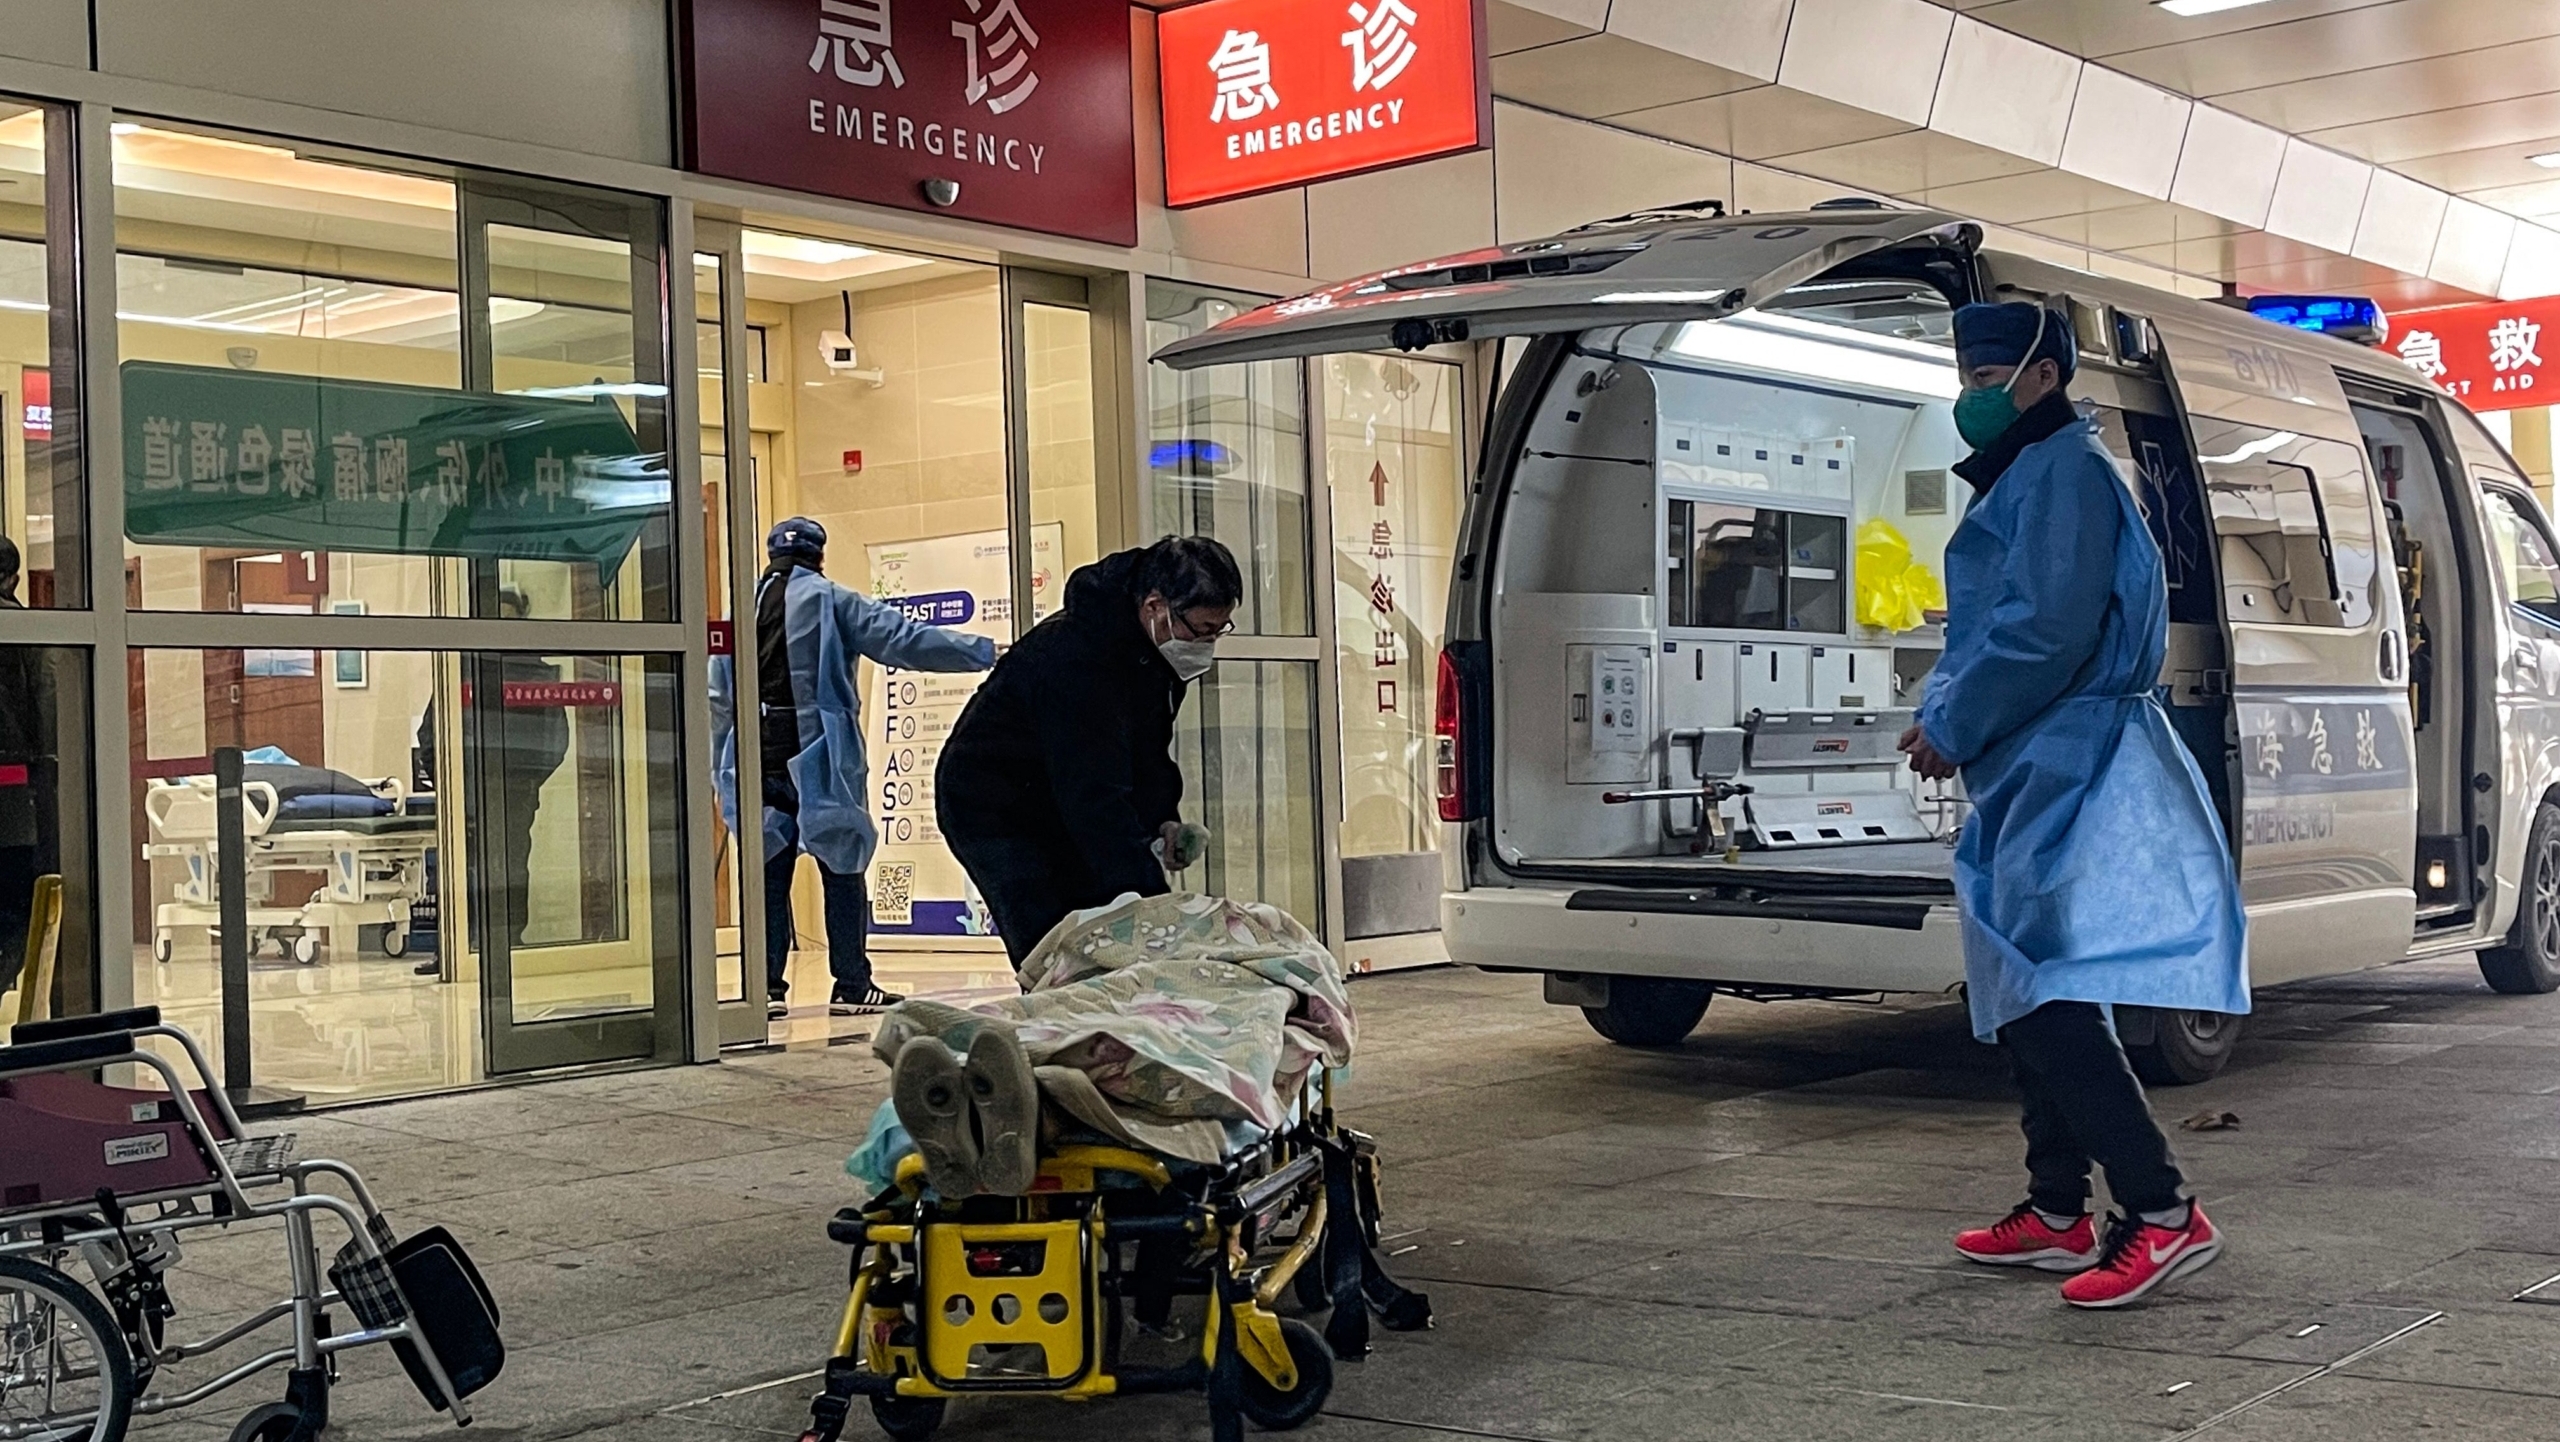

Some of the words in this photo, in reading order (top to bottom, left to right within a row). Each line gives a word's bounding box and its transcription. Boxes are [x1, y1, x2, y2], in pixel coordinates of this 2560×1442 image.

[809, 0, 1040, 115] 急诊
[1208, 0, 1418, 123] 急诊
[809, 99, 1044, 175] EMERGENCY
[1226, 98, 1404, 159] EMERGENCY
[2396, 316, 2543, 379] 急救
[2493, 374, 2534, 392] AID
[300, 550, 317, 582] 1
[2243, 805, 2334, 846] EMERGENCY
